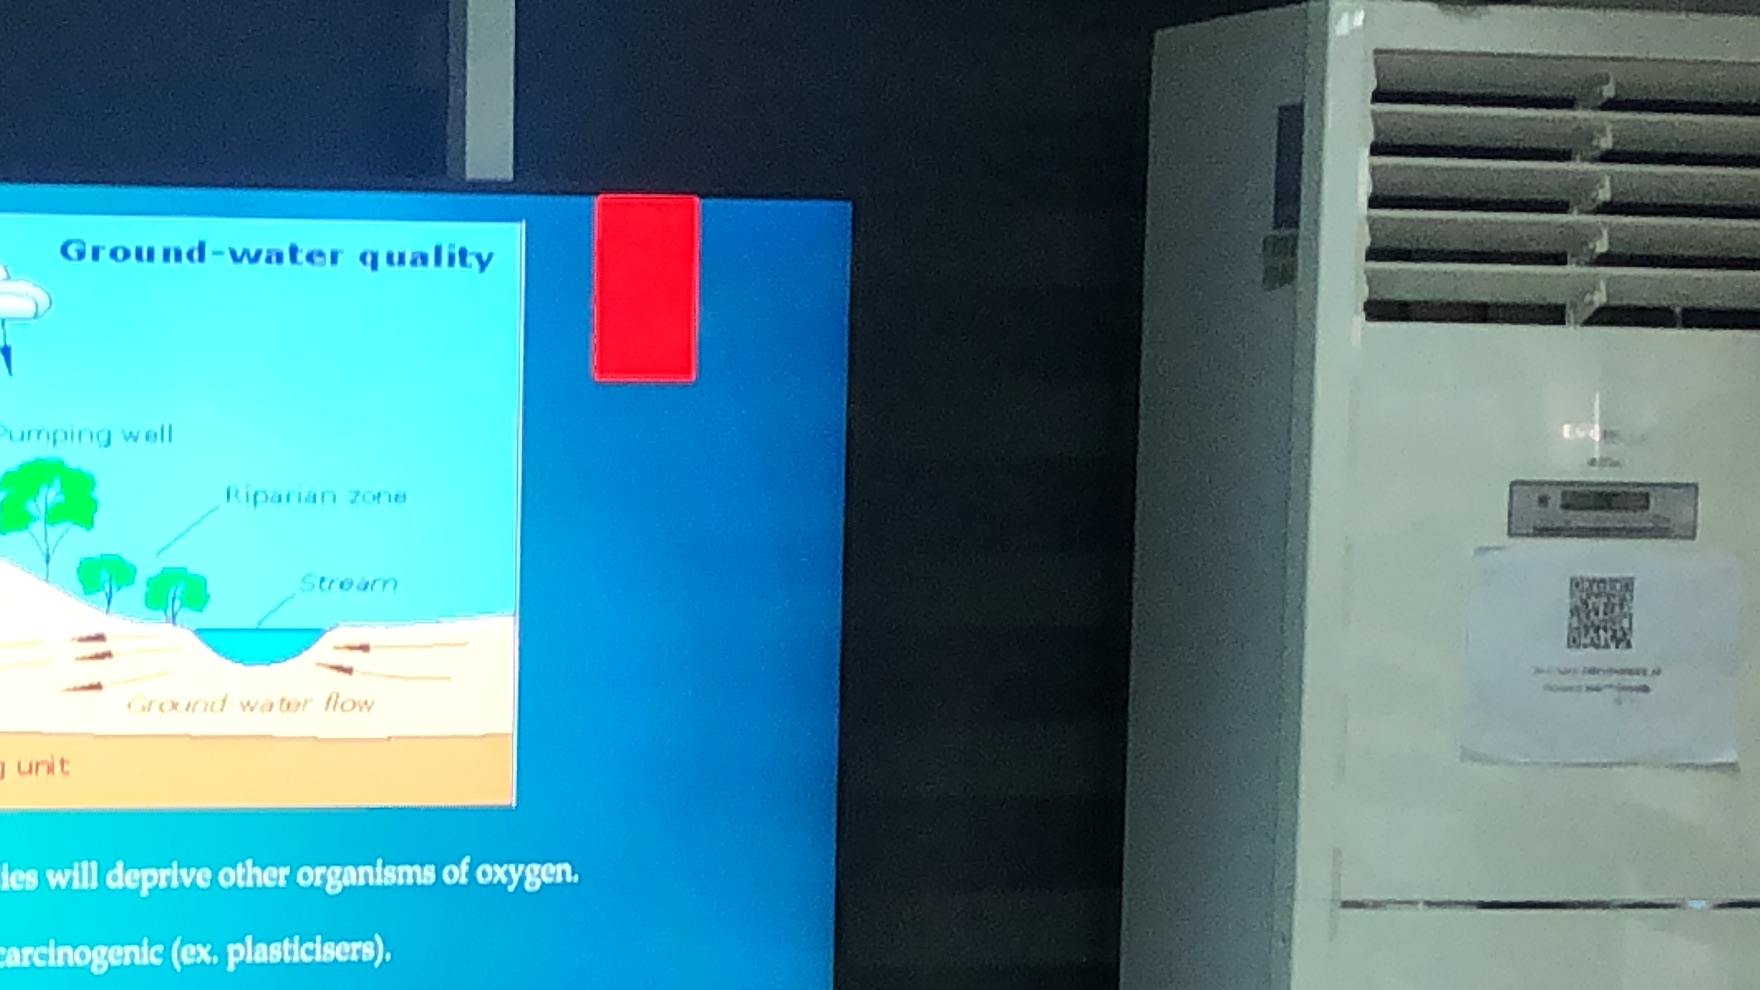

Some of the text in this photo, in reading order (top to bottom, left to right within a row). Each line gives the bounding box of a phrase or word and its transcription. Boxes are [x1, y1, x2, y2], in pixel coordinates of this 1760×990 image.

[59, 238, 495, 273] Ground-water quality
[122, 423, 174, 445] well
[225, 484, 408, 507] Riparian zone
[300, 573, 398, 594] Stream
[324, 690, 376, 714] flow
[17, 755, 71, 778] unit
[45, 859, 99, 890] will
[105, 859, 213, 898] deprive
[216, 858, 291, 889] other
[295, 857, 437, 896] organisms
[441, 855, 472, 885] of
[475, 861, 580, 893] oxygen.
[170, 936, 219, 973] (ex.
[226, 932, 392, 973] plasticisers).
